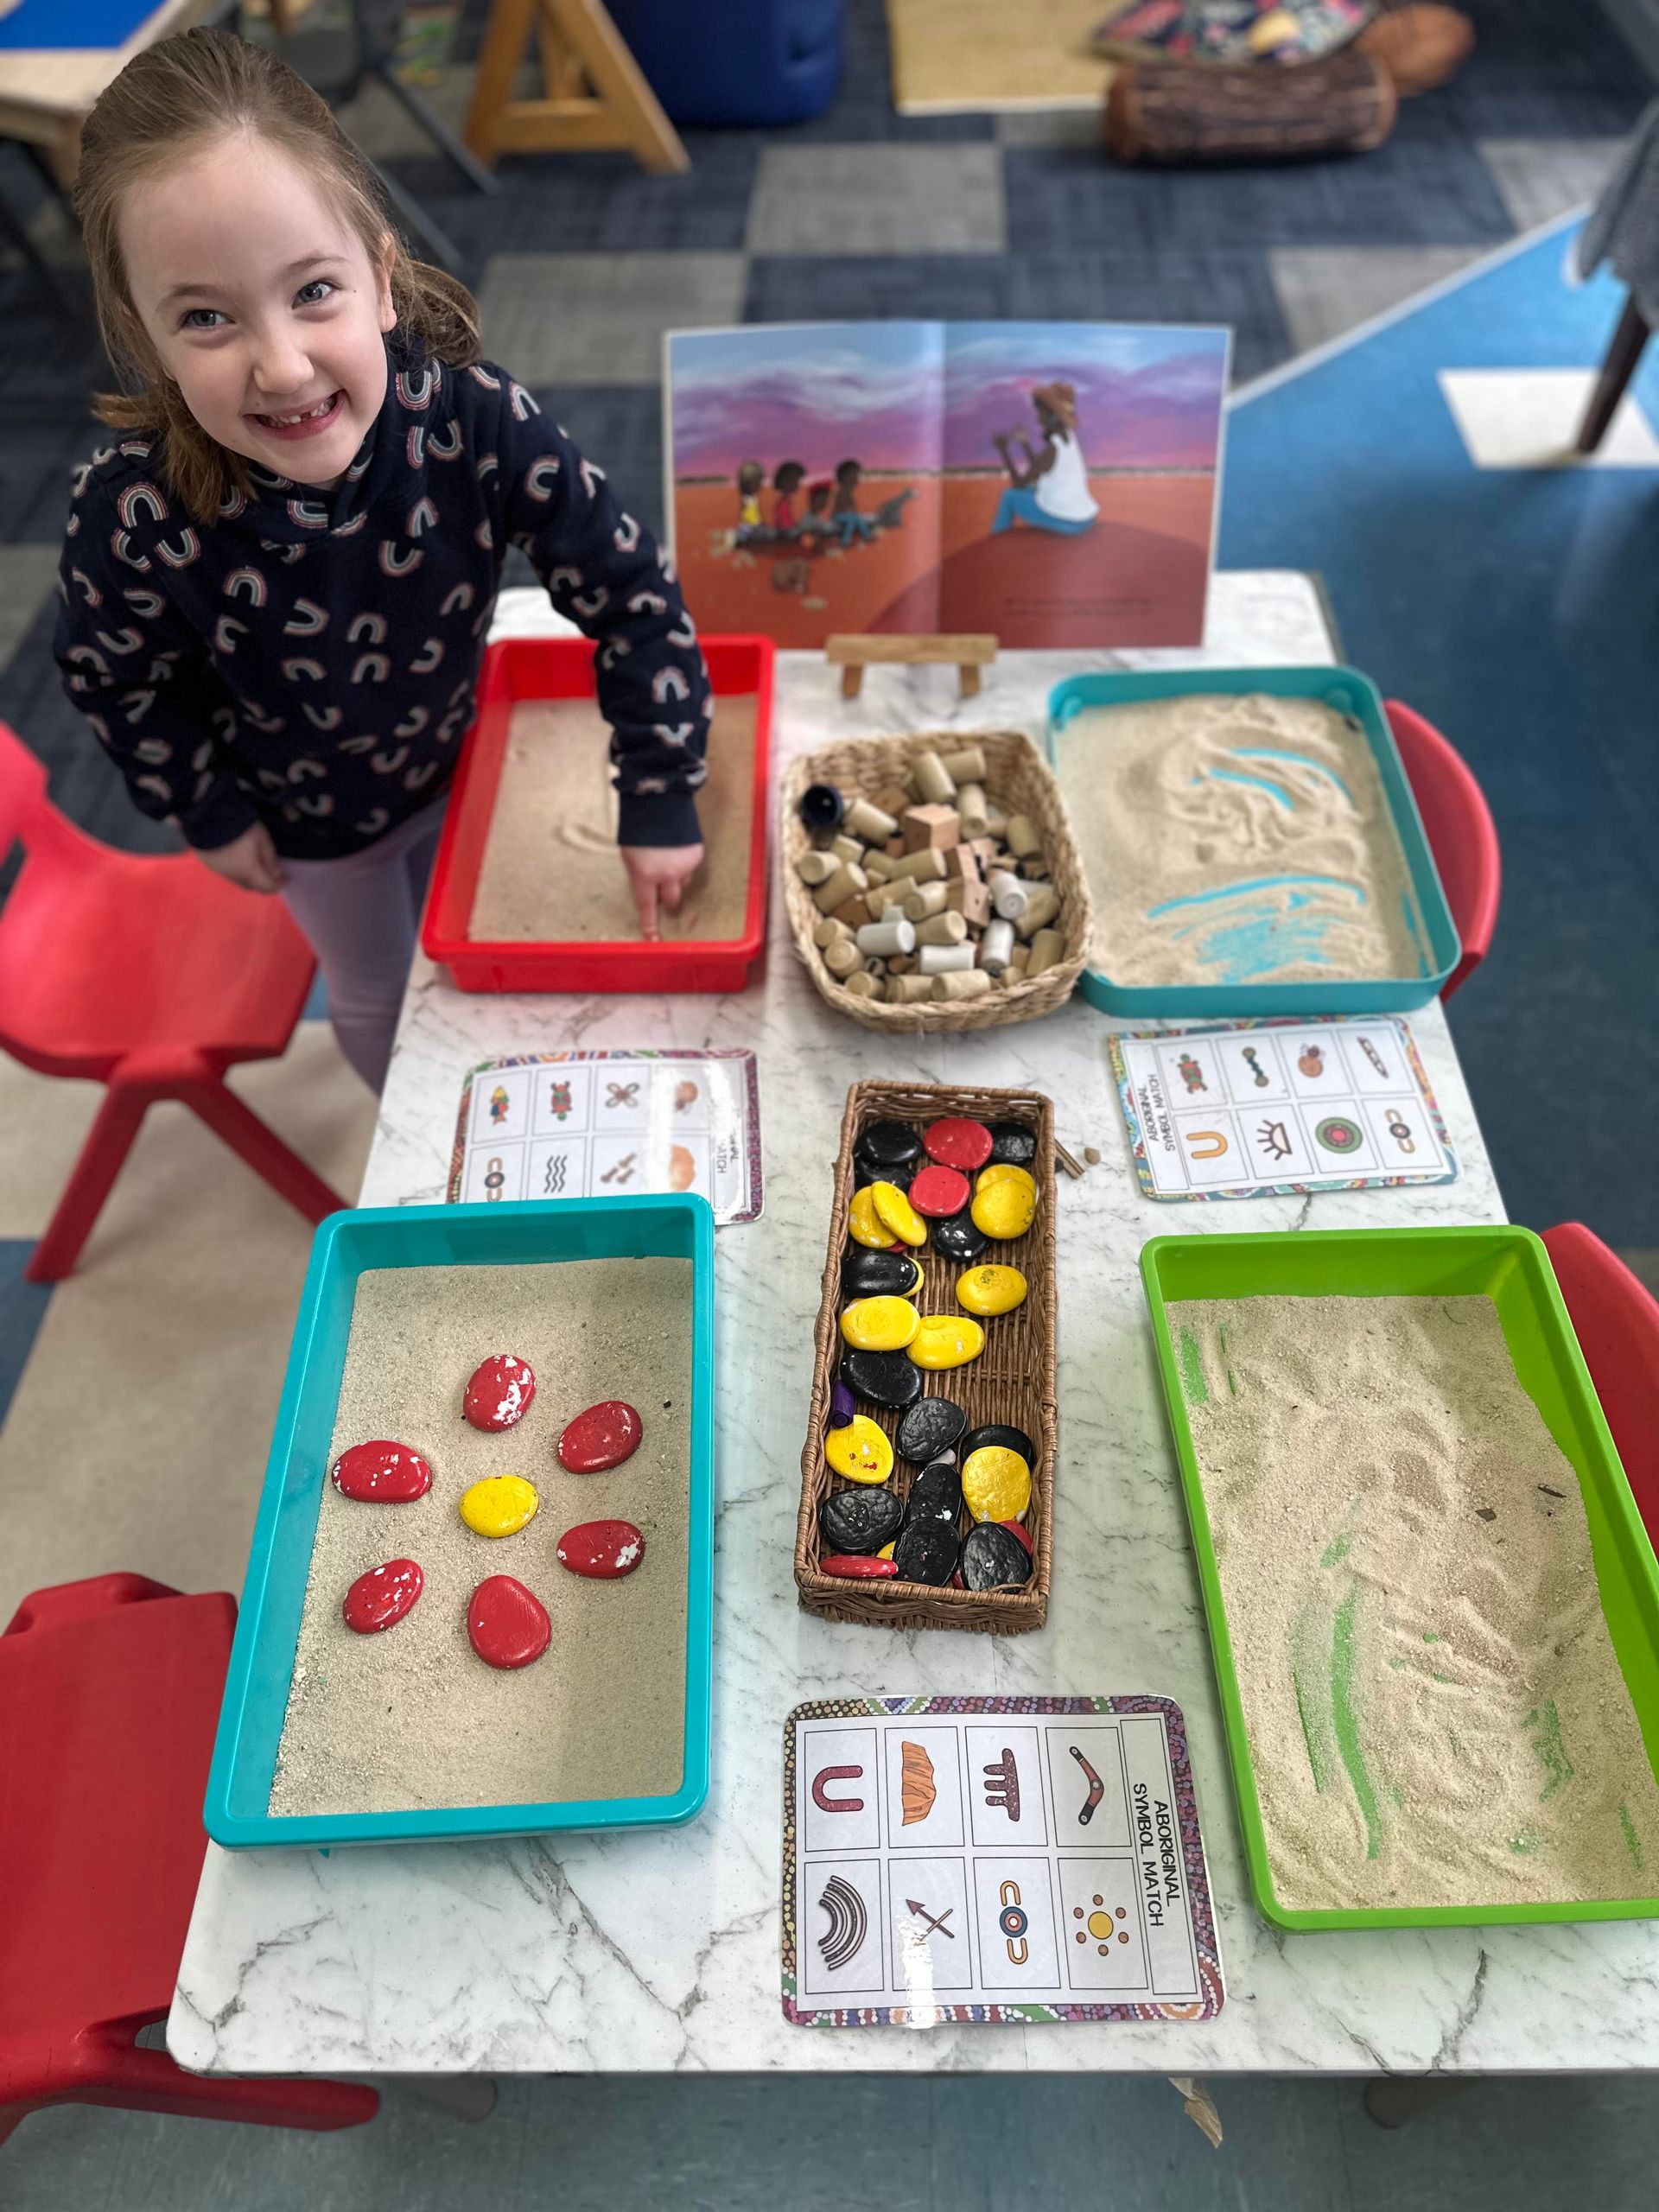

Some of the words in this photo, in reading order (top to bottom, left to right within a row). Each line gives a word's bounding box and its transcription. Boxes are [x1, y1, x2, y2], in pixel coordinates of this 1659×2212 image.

[1137, 1084, 1159, 1141] ABORIGINAL
[1147, 1074, 1165, 1108] MATCH
[716, 1139, 727, 1174] ATCH
[1158, 1111, 1175, 1152] SYMBOL
[1133, 1783, 1154, 1854] SYMBOL
[1154, 1800, 1180, 1907] ABORIGINAL
[1142, 1861, 1164, 1927] MATCH
